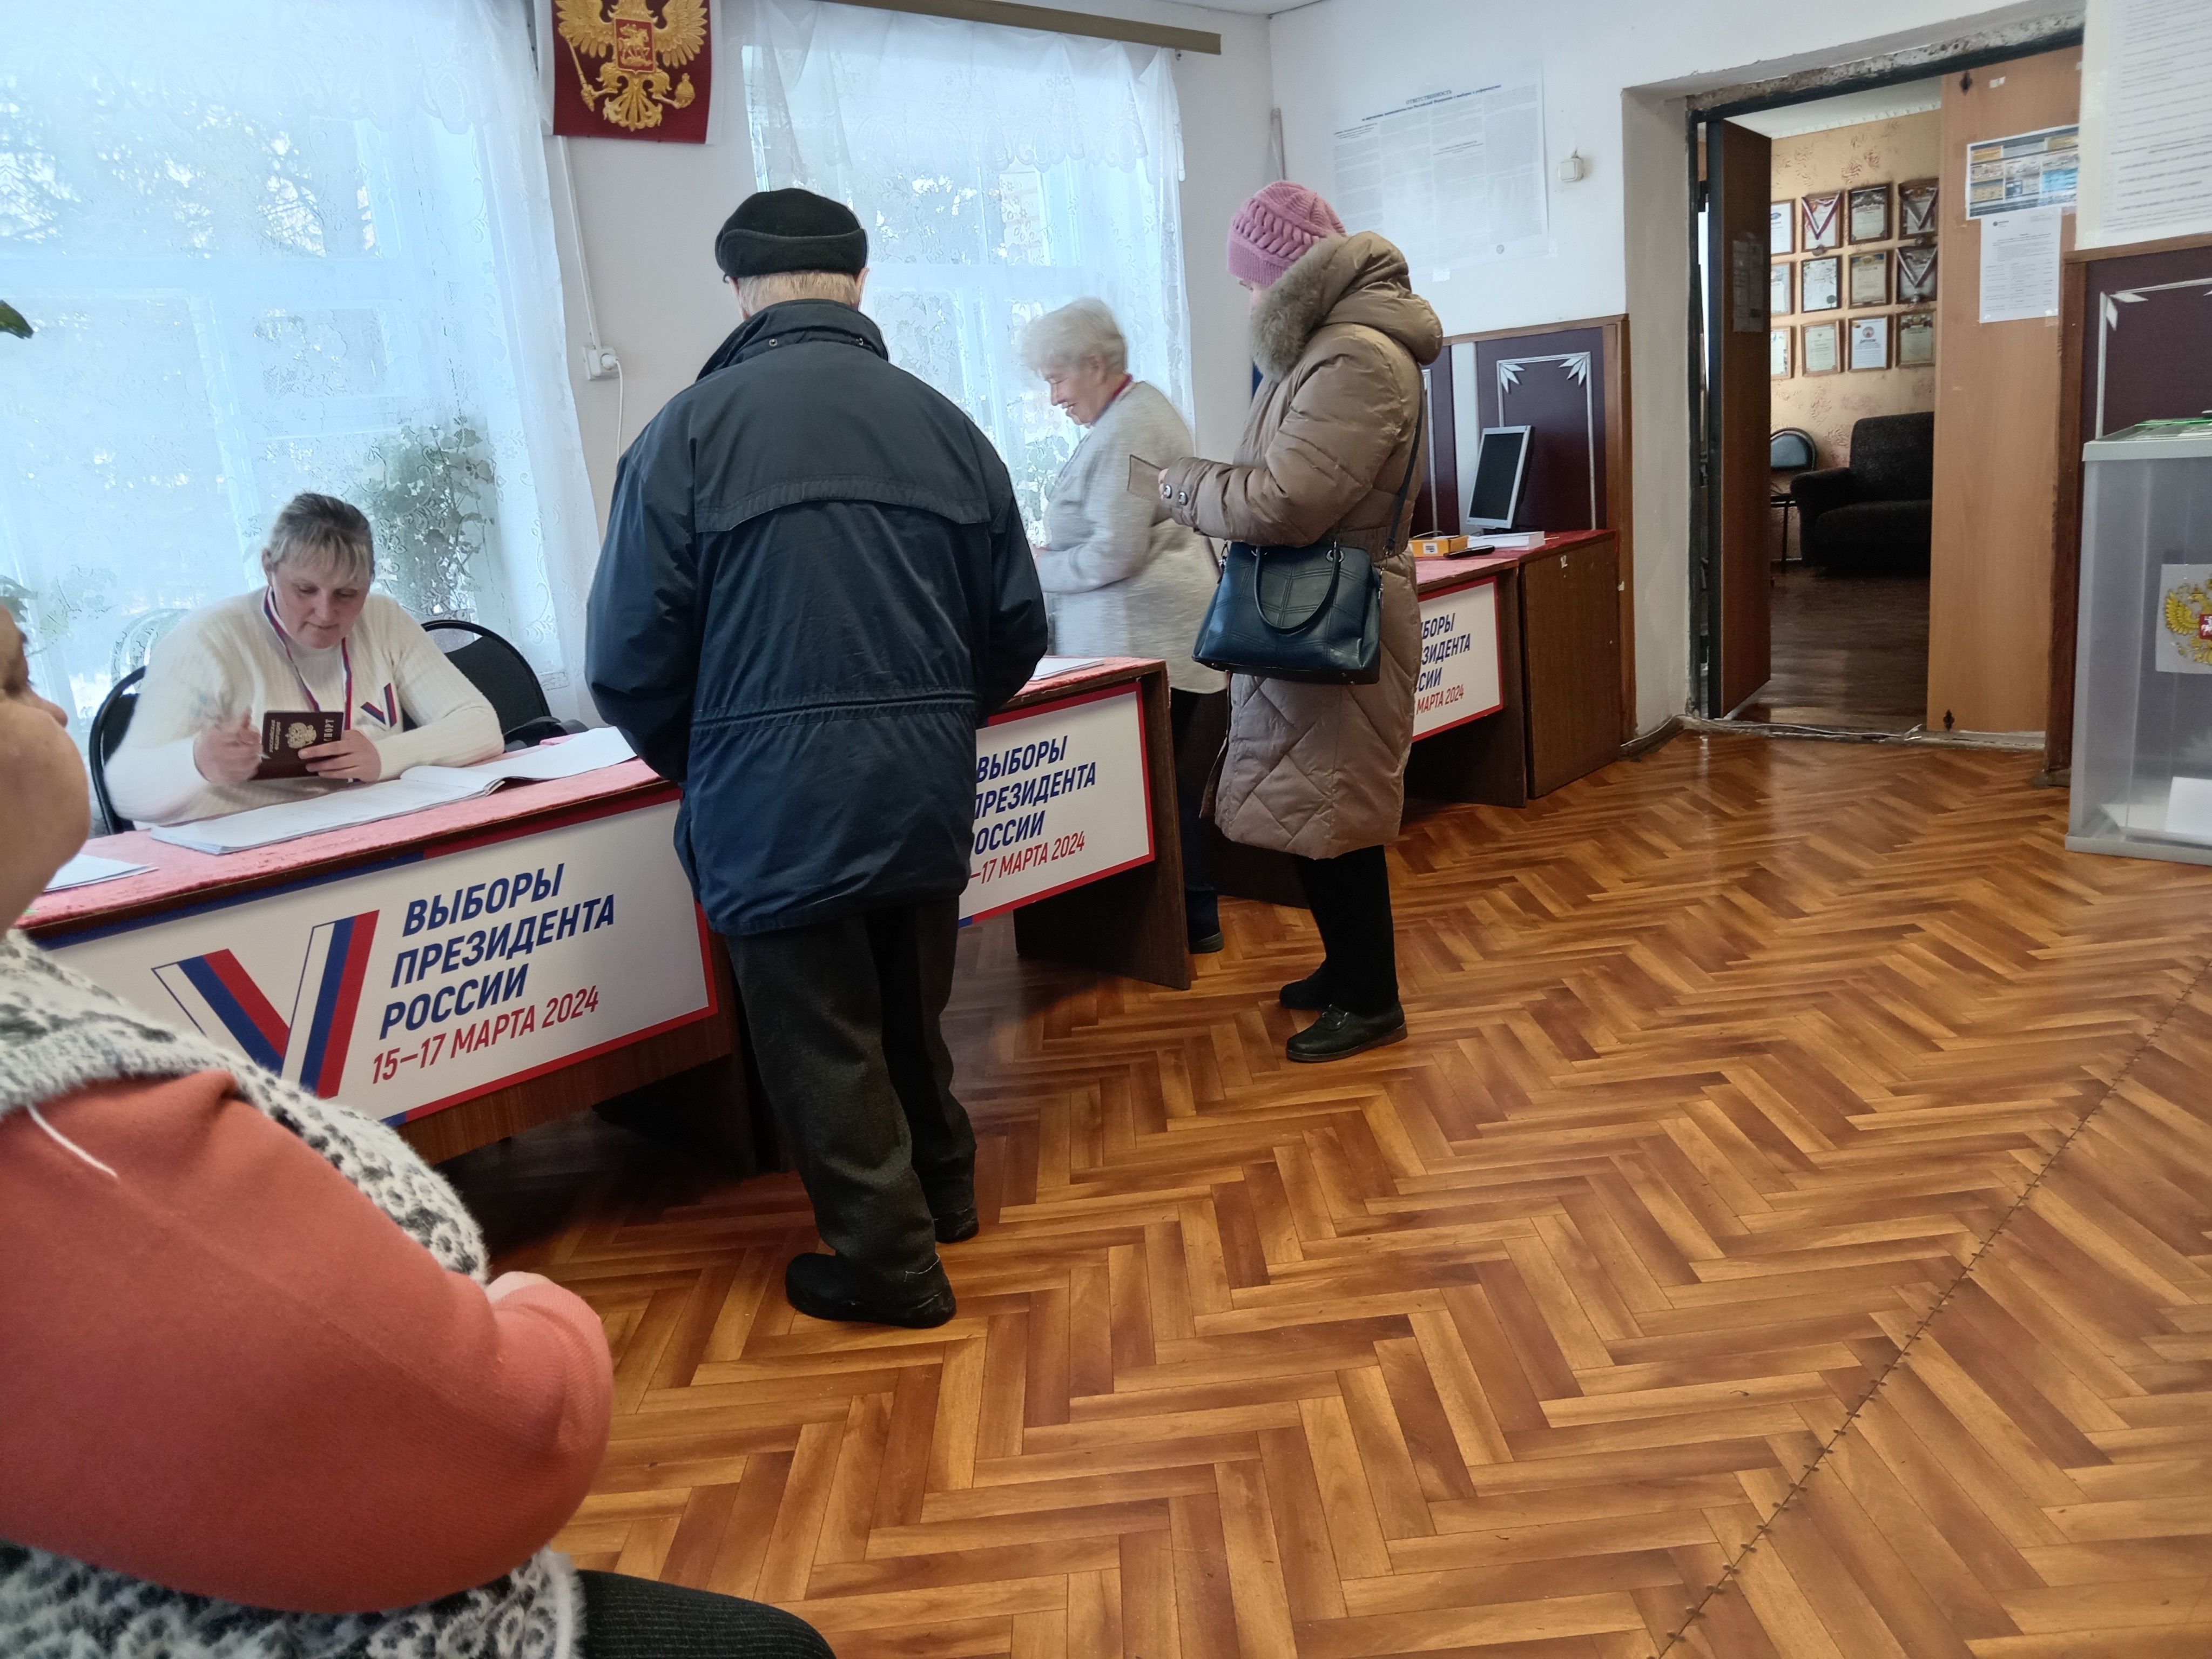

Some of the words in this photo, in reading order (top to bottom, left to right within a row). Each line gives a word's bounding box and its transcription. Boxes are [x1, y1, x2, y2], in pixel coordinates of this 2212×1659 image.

[1421, 613, 1456, 639] БОРЫ
[1421, 633, 1471, 665] ЗИДЕНТА
[1416, 667, 1442, 692] СИИ
[1416, 691, 1444, 715] МАРТА
[1445, 684, 1464, 705] 2024
[323, 719, 334, 741] СПОРТ
[976, 736, 1068, 784] ВЫБОРЫ
[974, 811, 1046, 855] ОССИИ
[999, 842, 1049, 879] МАРТА
[1051, 831, 1085, 861] 2024
[401, 863, 565, 937] ВЫБОРЫ
[390, 894, 615, 988] ПРЕЗИДЕНТА
[379, 965, 528, 1040] РОССИИ
[450, 1002, 536, 1060] МАРТА
[541, 985, 599, 1028] 2024
